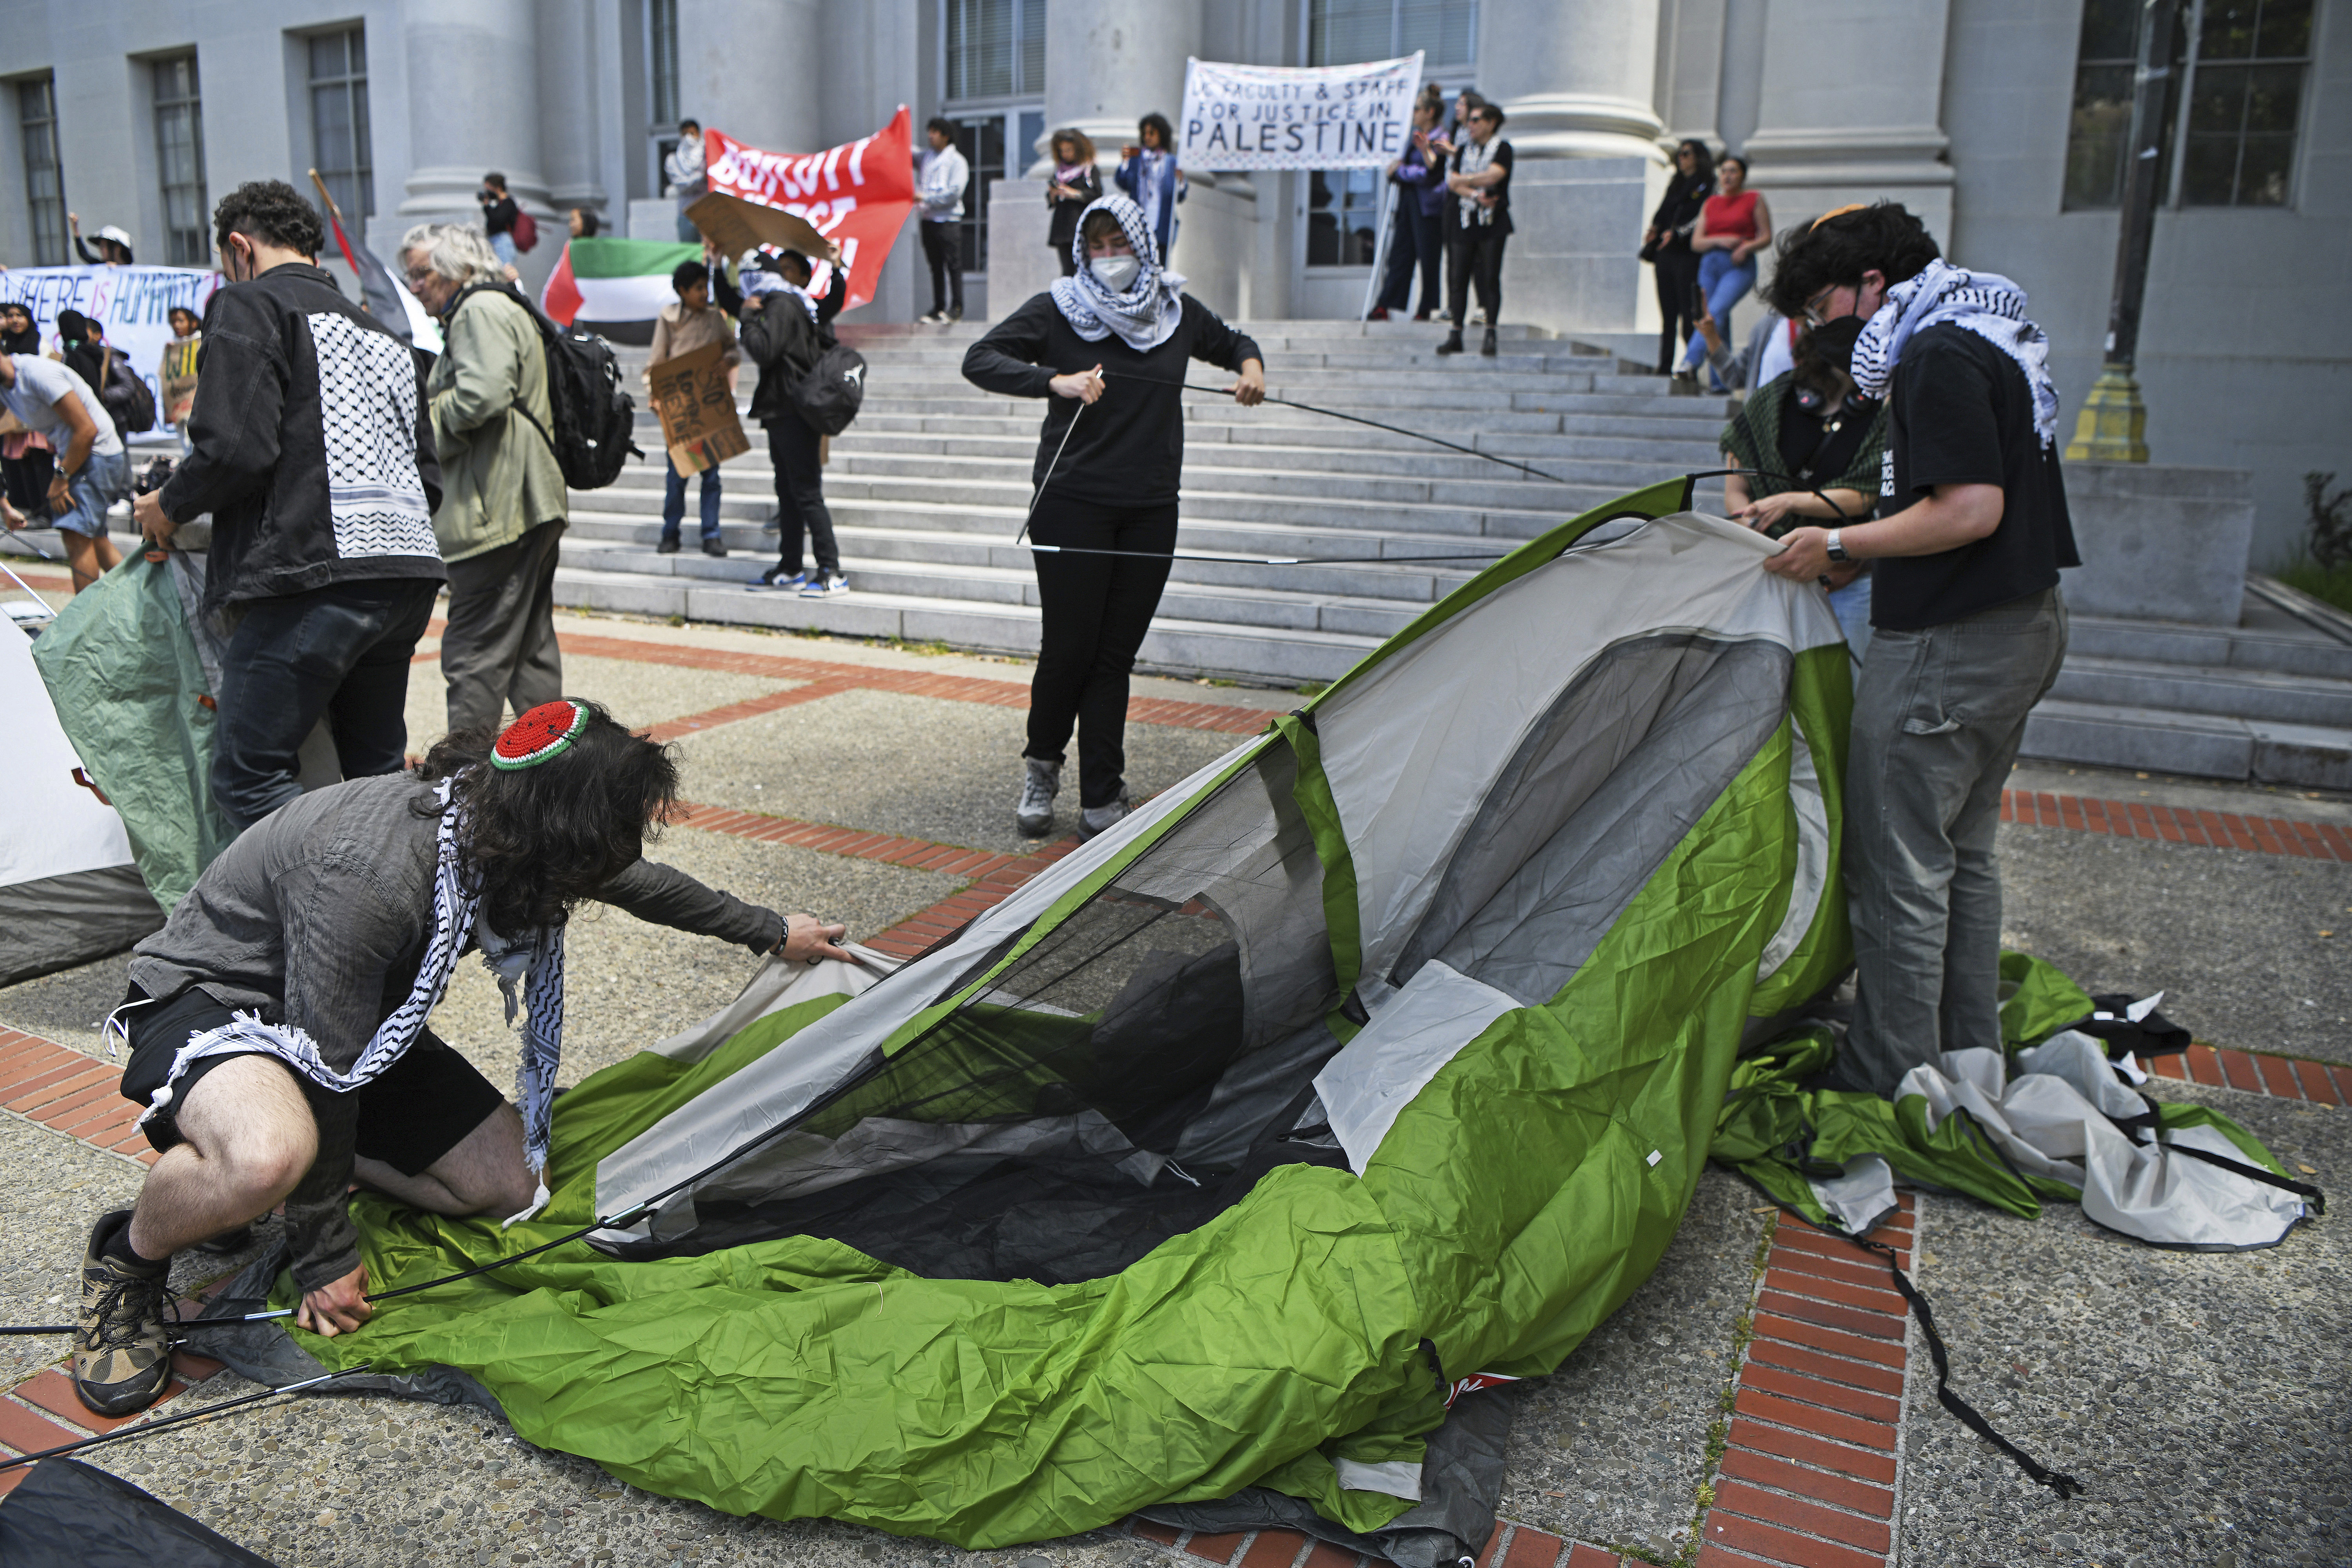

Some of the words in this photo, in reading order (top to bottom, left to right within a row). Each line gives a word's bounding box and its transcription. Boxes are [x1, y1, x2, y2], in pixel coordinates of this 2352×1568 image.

[1223, 82, 1301, 100] FACULTY
[1314, 83, 1329, 100] &
[1343, 80, 1409, 100] STAFF
[1196, 102, 1240, 120] FOR
[1253, 102, 1356, 120] JUSTICE
[1368, 102, 1392, 118] IN
[1187, 120, 1401, 153] PALESTINE
[89, 281, 110, 319] IS
